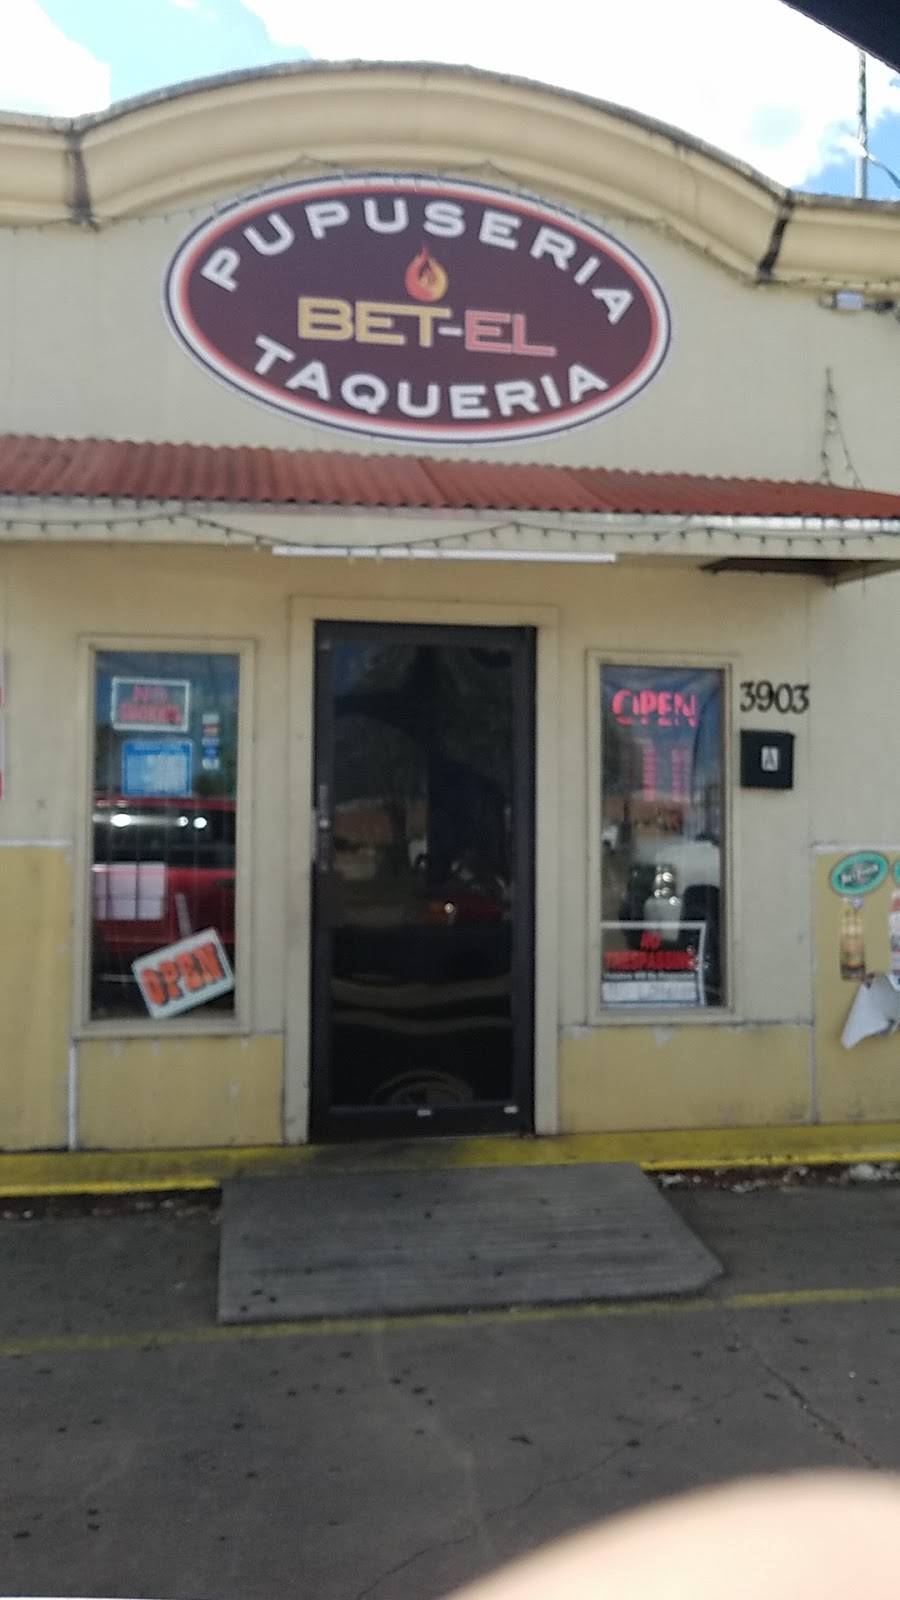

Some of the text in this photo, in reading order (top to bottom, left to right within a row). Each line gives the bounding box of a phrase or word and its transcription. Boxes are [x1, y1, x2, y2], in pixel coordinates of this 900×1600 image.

[200, 198, 634, 325] PUPUSERIA
[298, 296, 557, 358] BET-EL
[254, 335, 609, 419] TAQUERIA
[612, 688, 698, 728] OPEN
[739, 679, 811, 715] 3903
[142, 943, 224, 1006] OPEN
